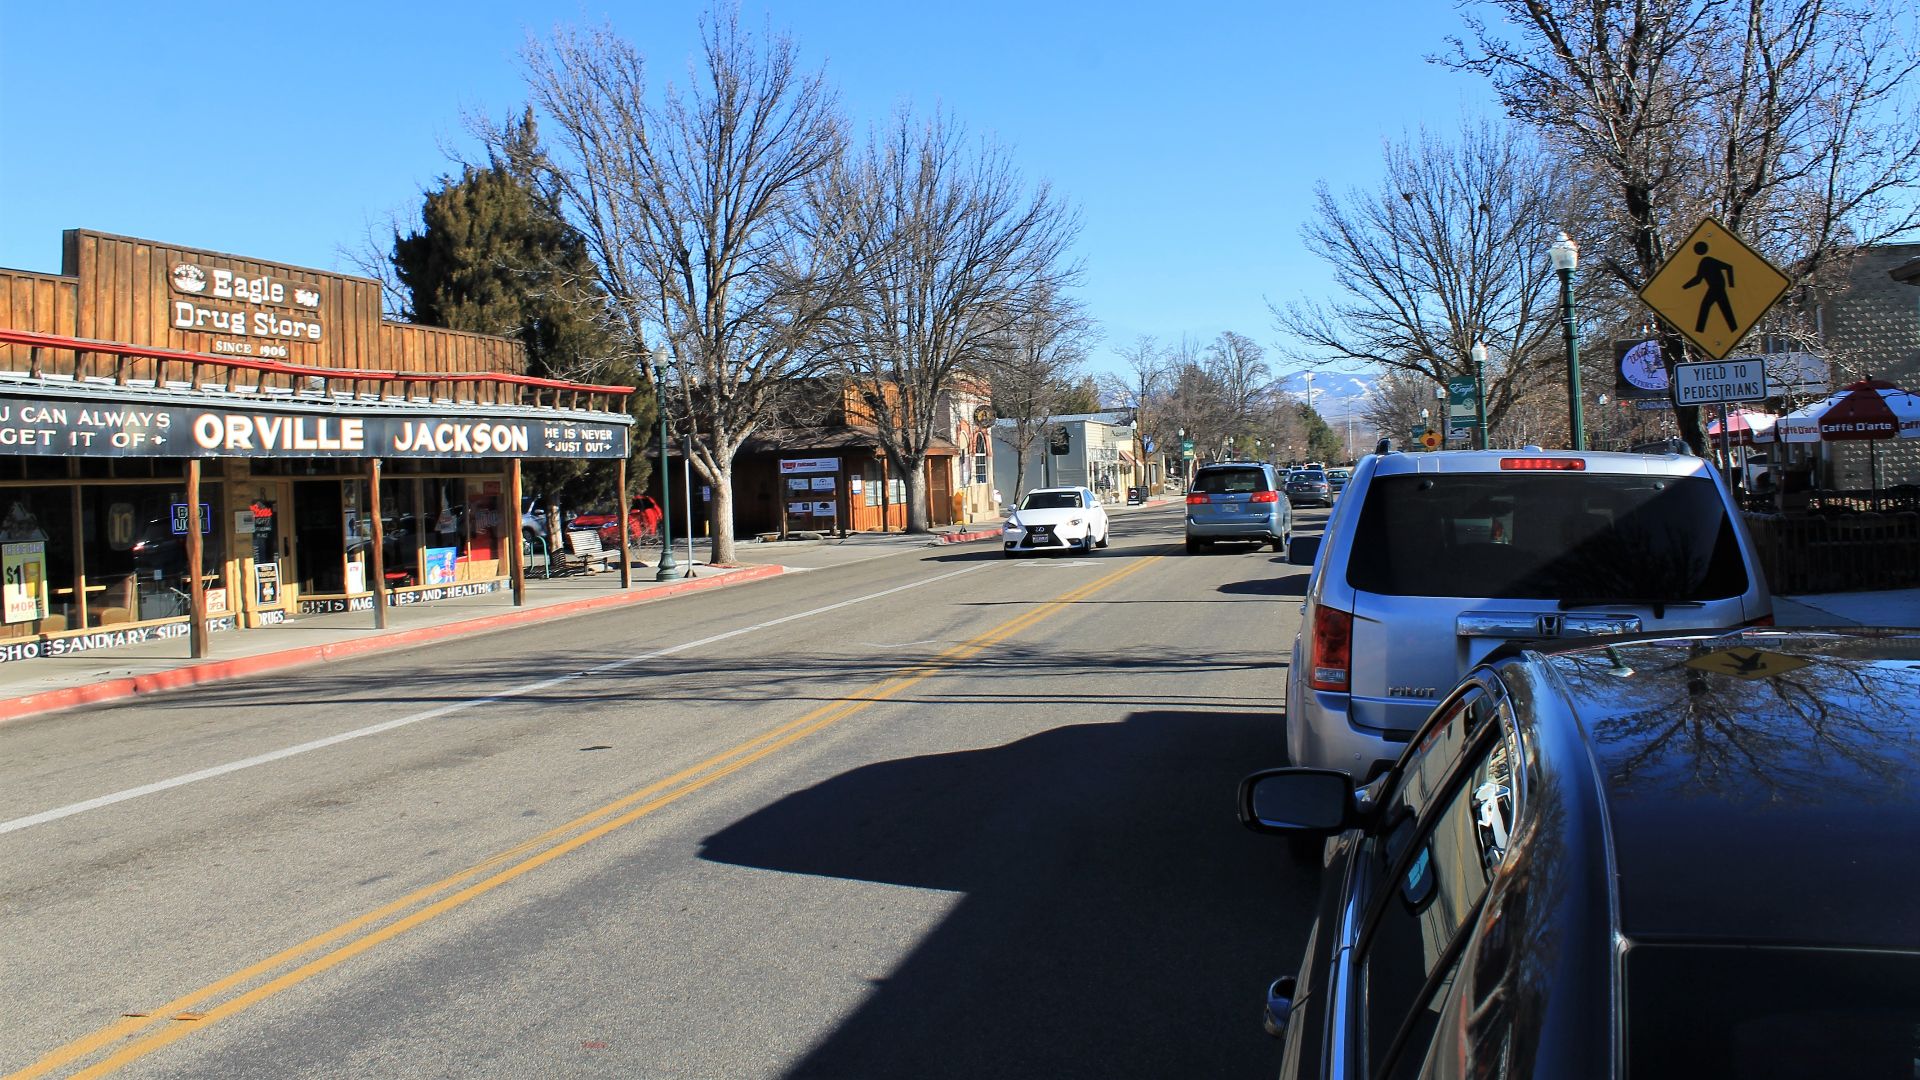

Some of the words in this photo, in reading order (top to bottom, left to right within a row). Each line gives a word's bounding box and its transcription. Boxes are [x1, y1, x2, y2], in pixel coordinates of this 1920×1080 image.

[212, 269, 284, 304] Eagle
[175, 301, 246, 335] Drug
[254, 312, 321, 340] Store
[216, 340, 251, 354] SINCE
[260, 345, 286, 357] 1906
[1693, 365, 1726, 381] YIELD
[1733, 365, 1747, 379] TO
[1684, 382, 1759, 400] PEDESTRIANS
[20, 407, 68, 425] CAN
[77, 409, 171, 428] ALWAYS
[0, 428, 56, 446] GET
[70, 431, 96, 447] IT
[111, 433, 145, 448] OF
[193, 413, 364, 450] ORVILLE
[394, 421, 528, 453] JACKSON
[545, 427, 559, 439] HE
[564, 428, 576, 439] IS
[581, 429, 613, 440] NEVER
[555, 441, 581, 452] JUST
[585, 442, 604, 452] OUT
[11, 600, 43, 612] MORE
[156, 618, 227, 640] SUPIES
